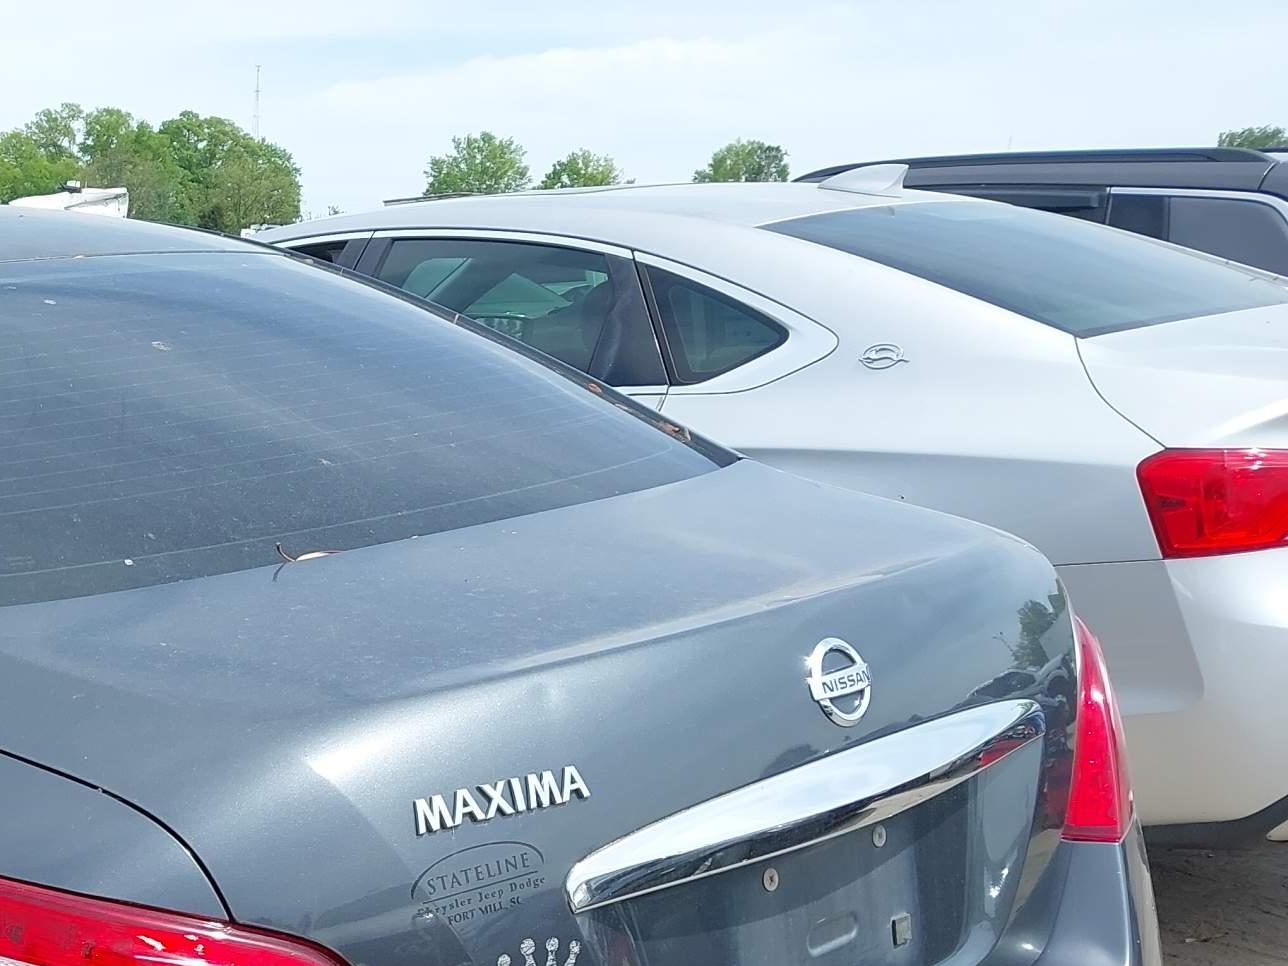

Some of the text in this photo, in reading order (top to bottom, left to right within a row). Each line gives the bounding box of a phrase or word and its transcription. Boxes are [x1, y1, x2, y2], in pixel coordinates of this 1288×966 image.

[821, 669, 871, 694] NISSAN
[413, 765, 591, 836] MAXIMA
[427, 852, 530, 896] STATELINE
[478, 888, 504, 903] Jeep
[510, 877, 545, 893] Dodge
[447, 909, 476, 925] FORT
